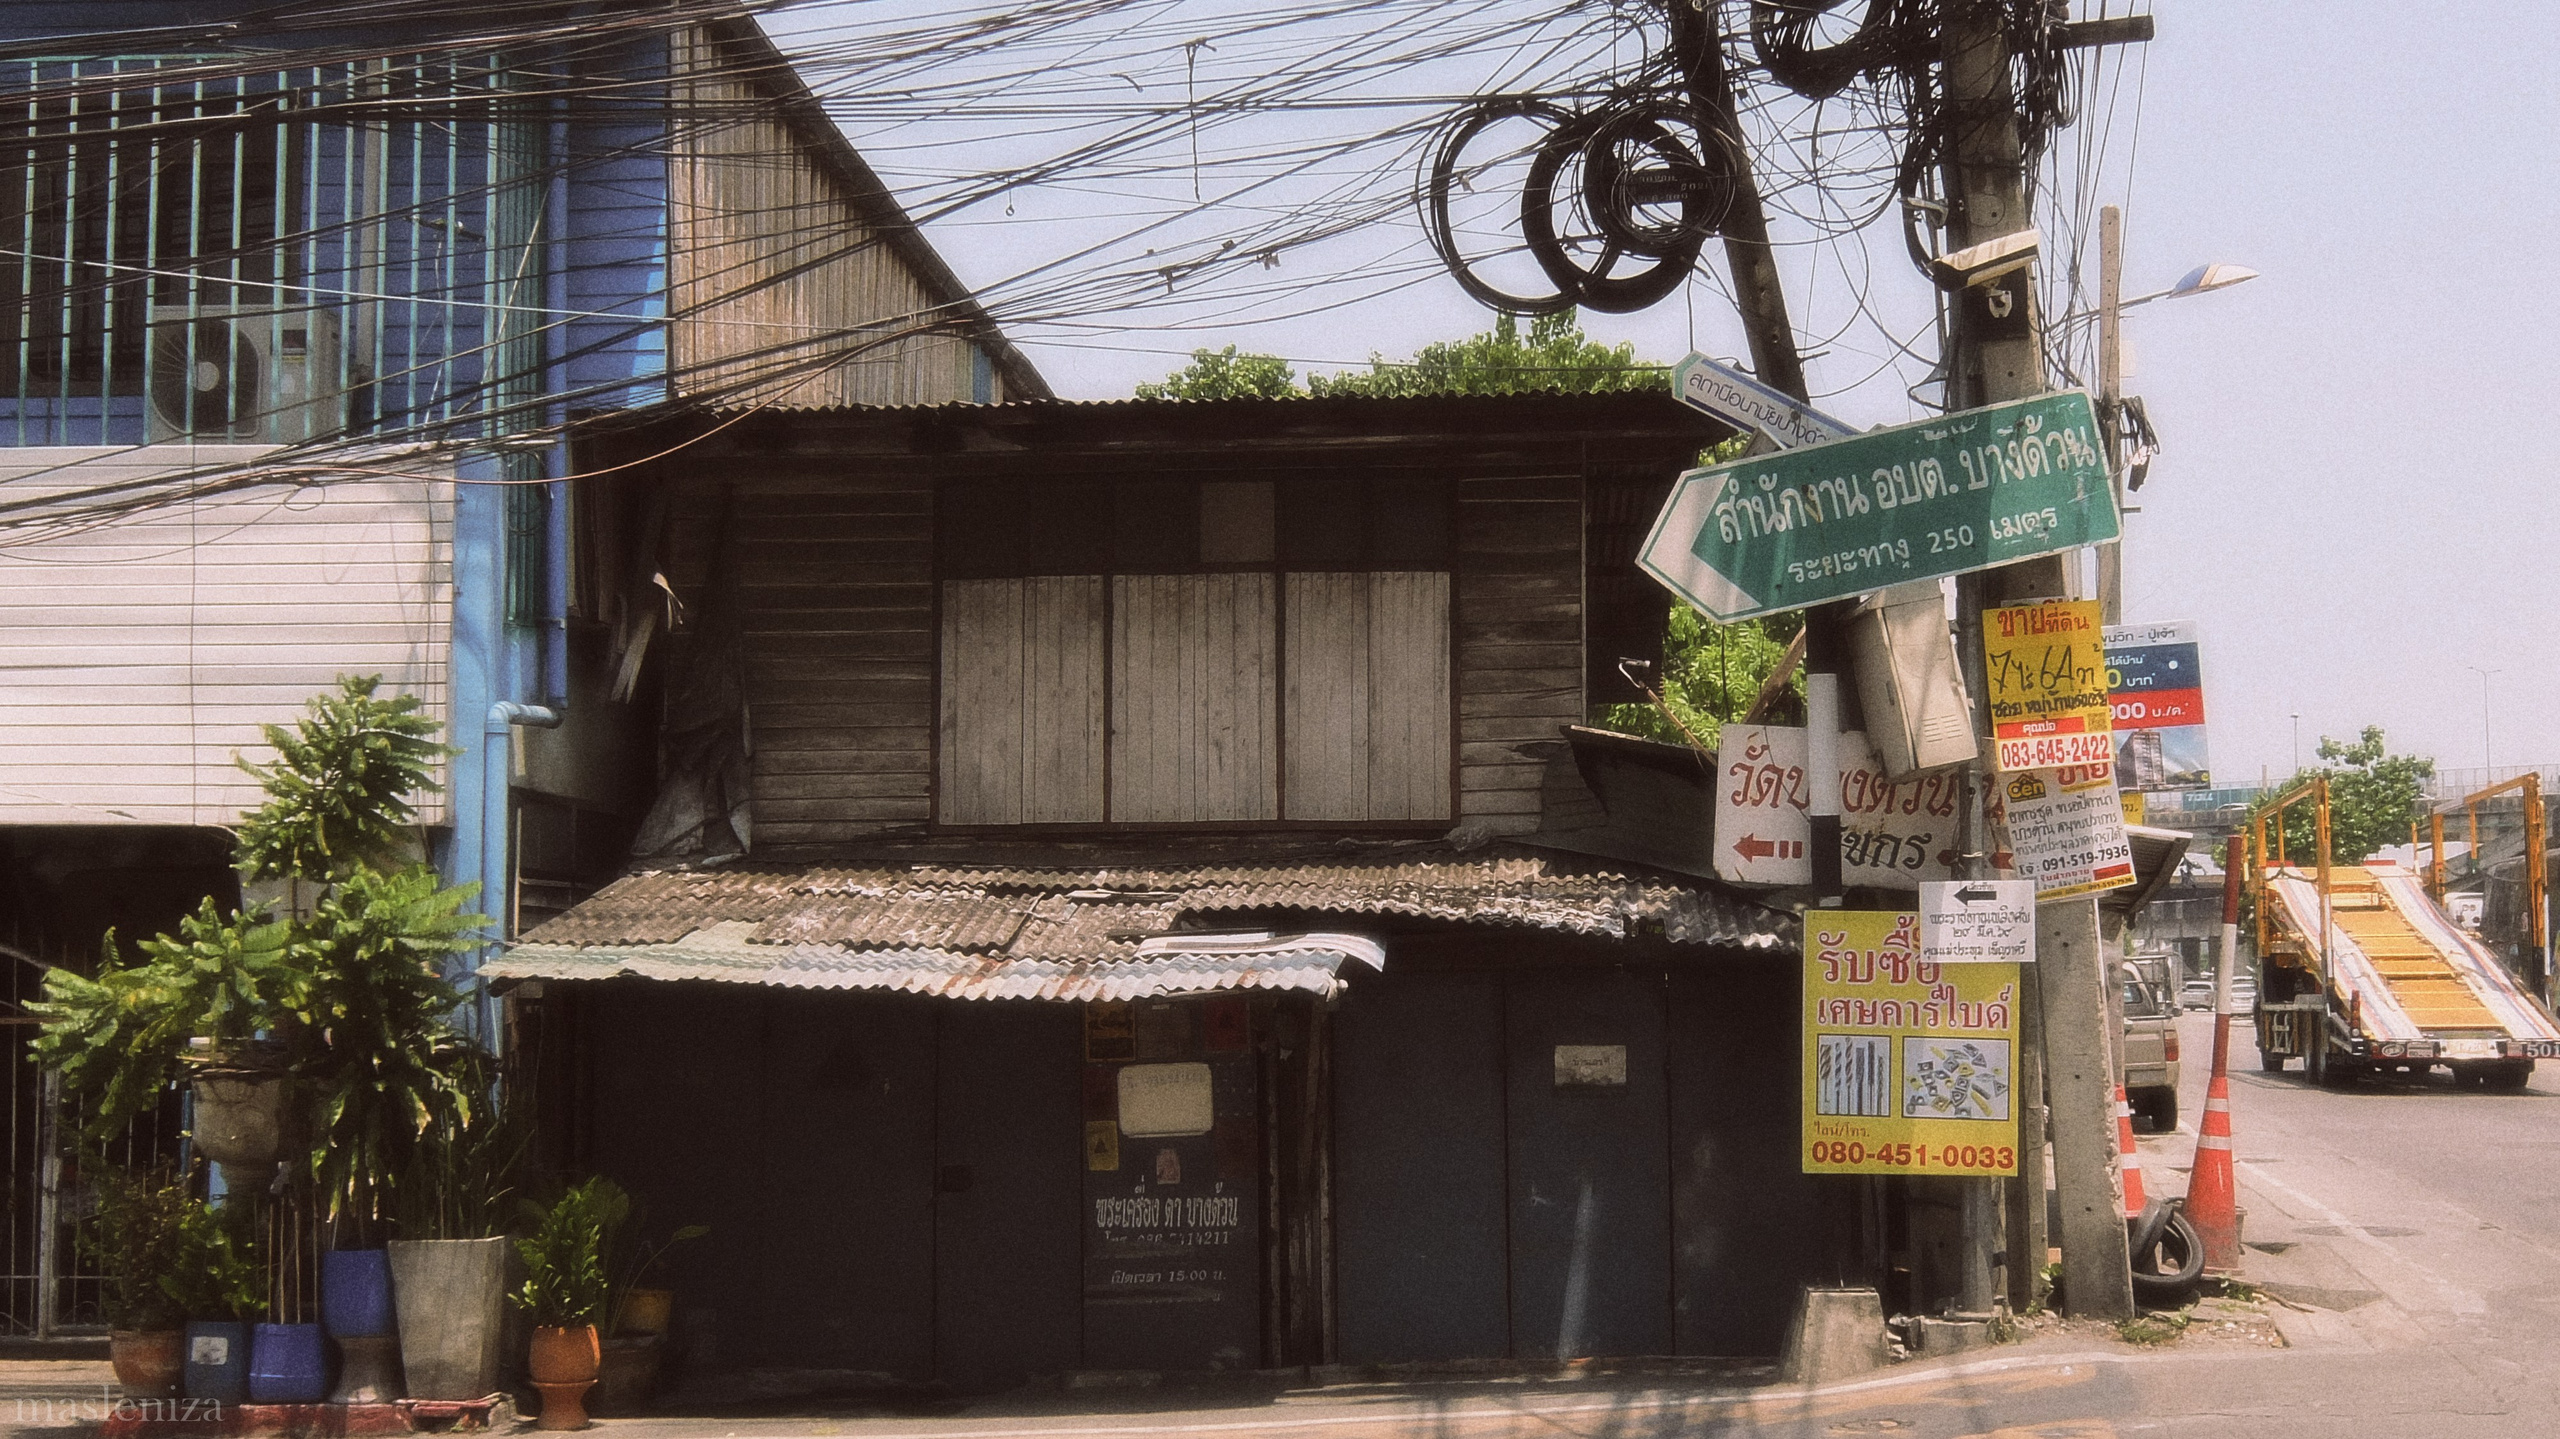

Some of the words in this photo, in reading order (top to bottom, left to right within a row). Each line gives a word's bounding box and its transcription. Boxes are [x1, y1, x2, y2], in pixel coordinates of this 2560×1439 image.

[1689, 373, 1830, 444] สถานีอนามัยบางด้
[1715, 473, 1870, 543] สำนักงาน
[1871, 457, 1959, 510] อบต.
[1960, 415, 2096, 491] บางด้วน
[1788, 539, 1910, 583] ระยะทาง
[1926, 525, 1974, 553] 250
[1990, 507, 2057, 540] เมตร
[1997, 607, 2090, 637] ขายที่ดิน
[2001, 735, 2110, 768] 083-645-2422
[2042, 845, 2130, 872] 091-519-7936
[1818, 915, 1940, 984] รับซื้อ
[1818, 984, 2010, 1029] เศษคาร์ไบด์
[1814, 1120, 1870, 1138] ไลน์/โทร.
[1811, 1141, 2014, 1170] 080-451-0033
